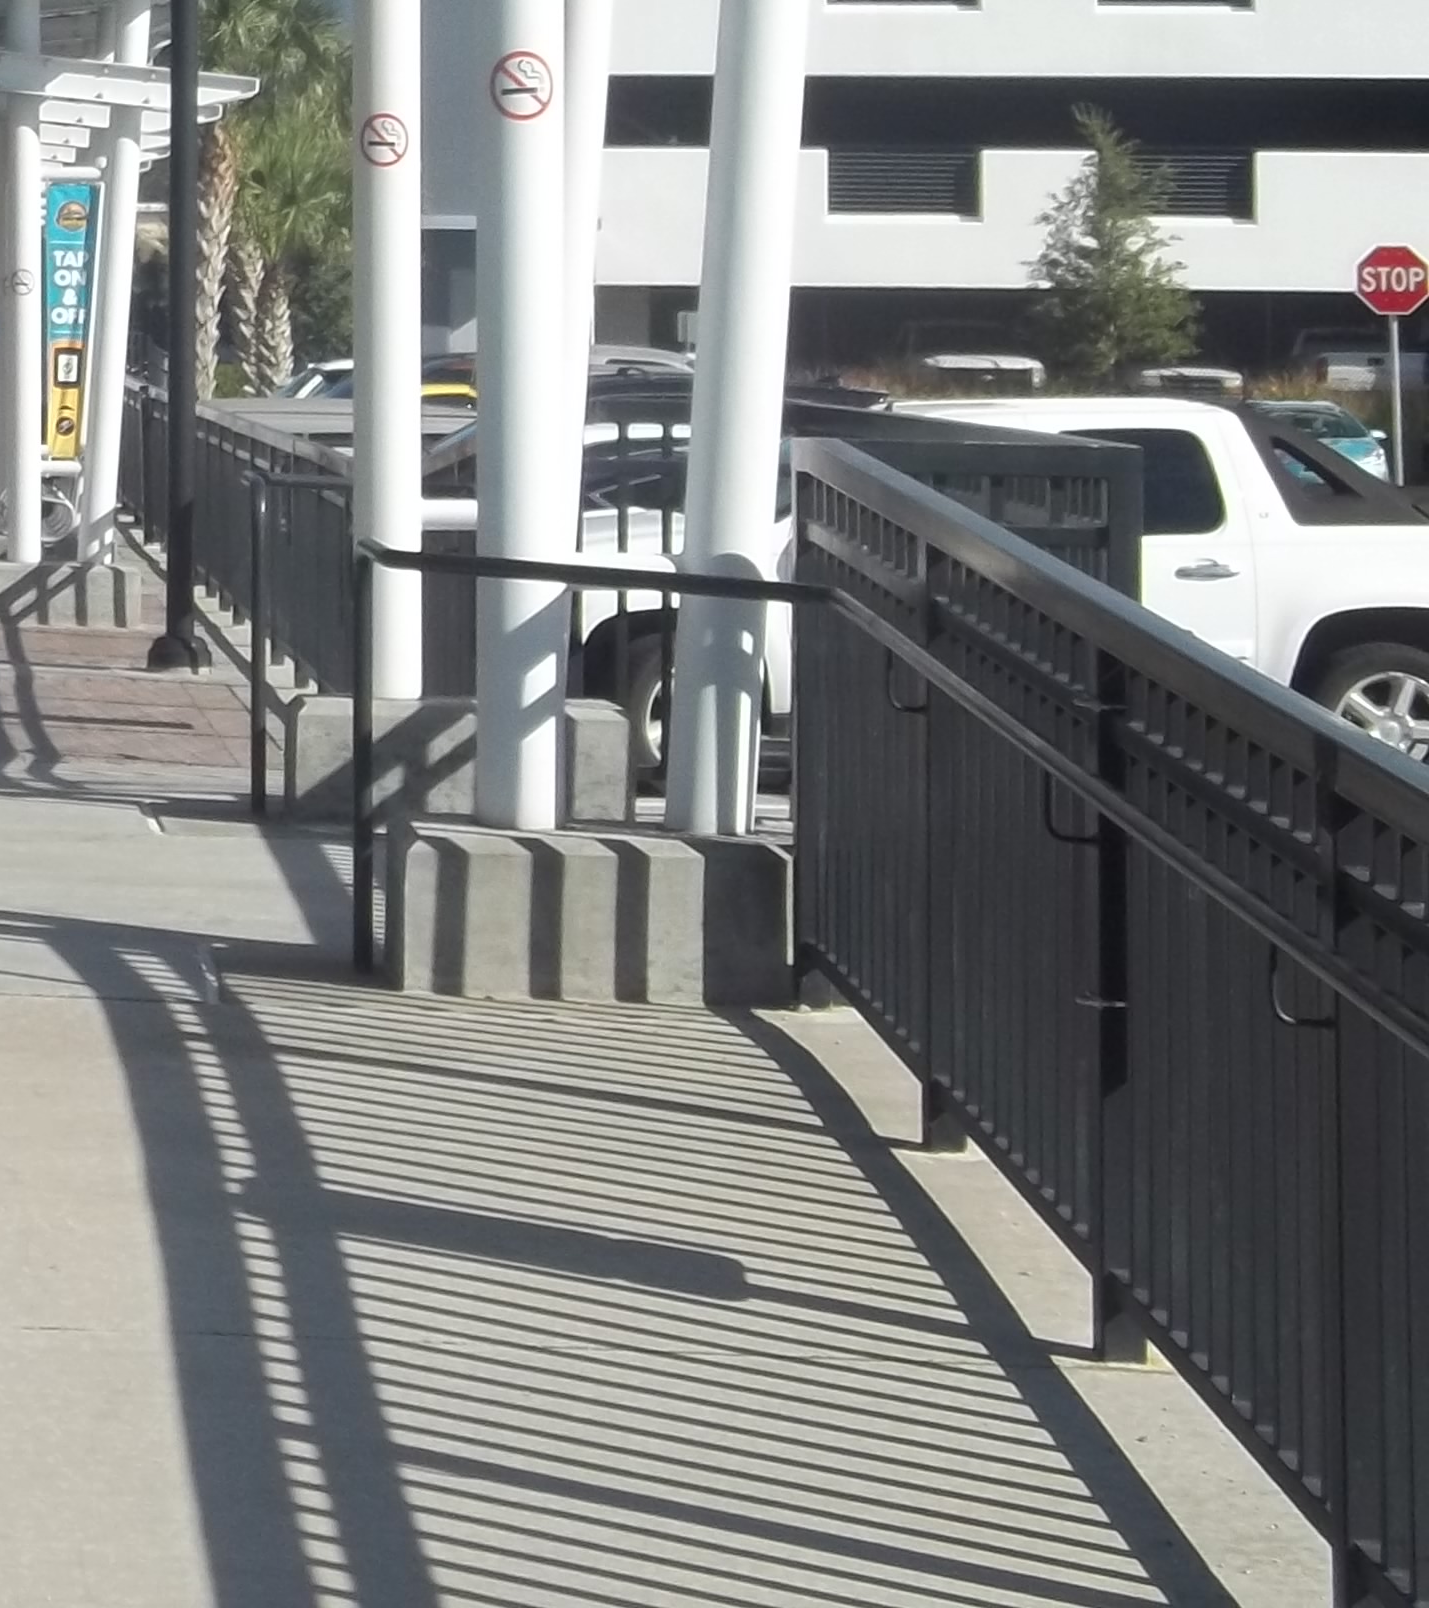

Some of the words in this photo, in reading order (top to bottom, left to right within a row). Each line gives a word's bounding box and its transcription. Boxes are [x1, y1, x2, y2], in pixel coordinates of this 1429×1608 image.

[53, 250, 89, 267] TAP
[54, 269, 87, 287] ON
[1361, 266, 1425, 293] STOP
[62, 288, 78, 305] &
[51, 307, 86, 324] OFF
